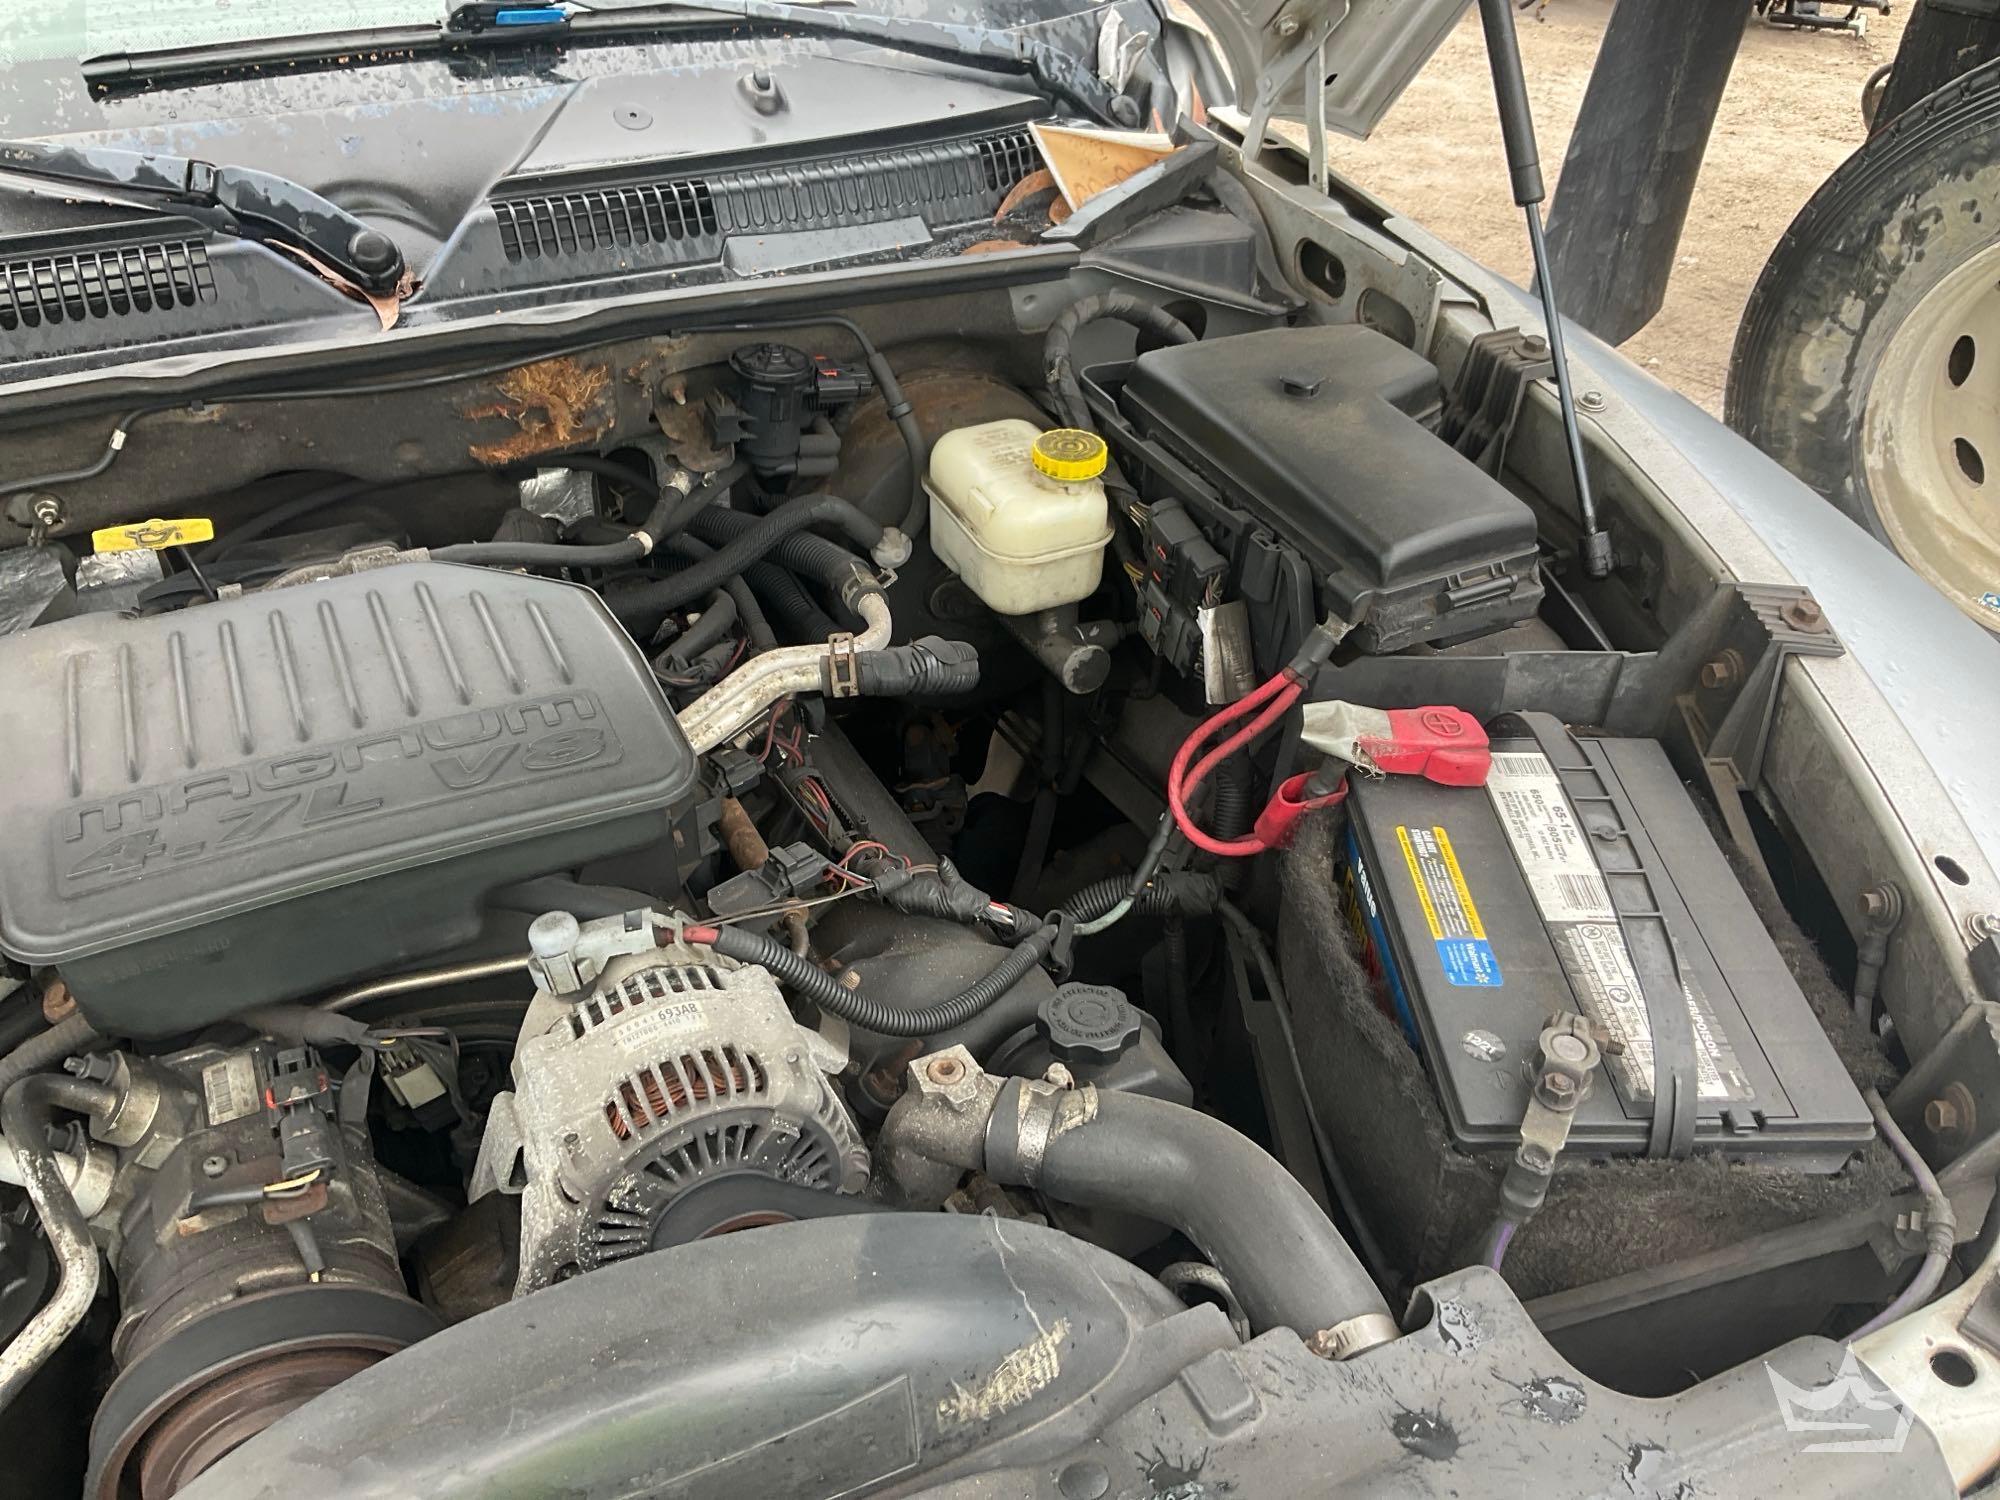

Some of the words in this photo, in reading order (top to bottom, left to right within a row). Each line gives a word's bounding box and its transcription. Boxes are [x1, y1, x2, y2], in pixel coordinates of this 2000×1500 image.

[67, 782, 384, 880] 4.7L
[431, 726, 606, 790] V8
[1530, 788, 1544, 806] 650
[1552, 805, 1573, 829] 65-1
[1466, 942, 1484, 975] Walmart
[658, 1002, 698, 1021] 693AB
